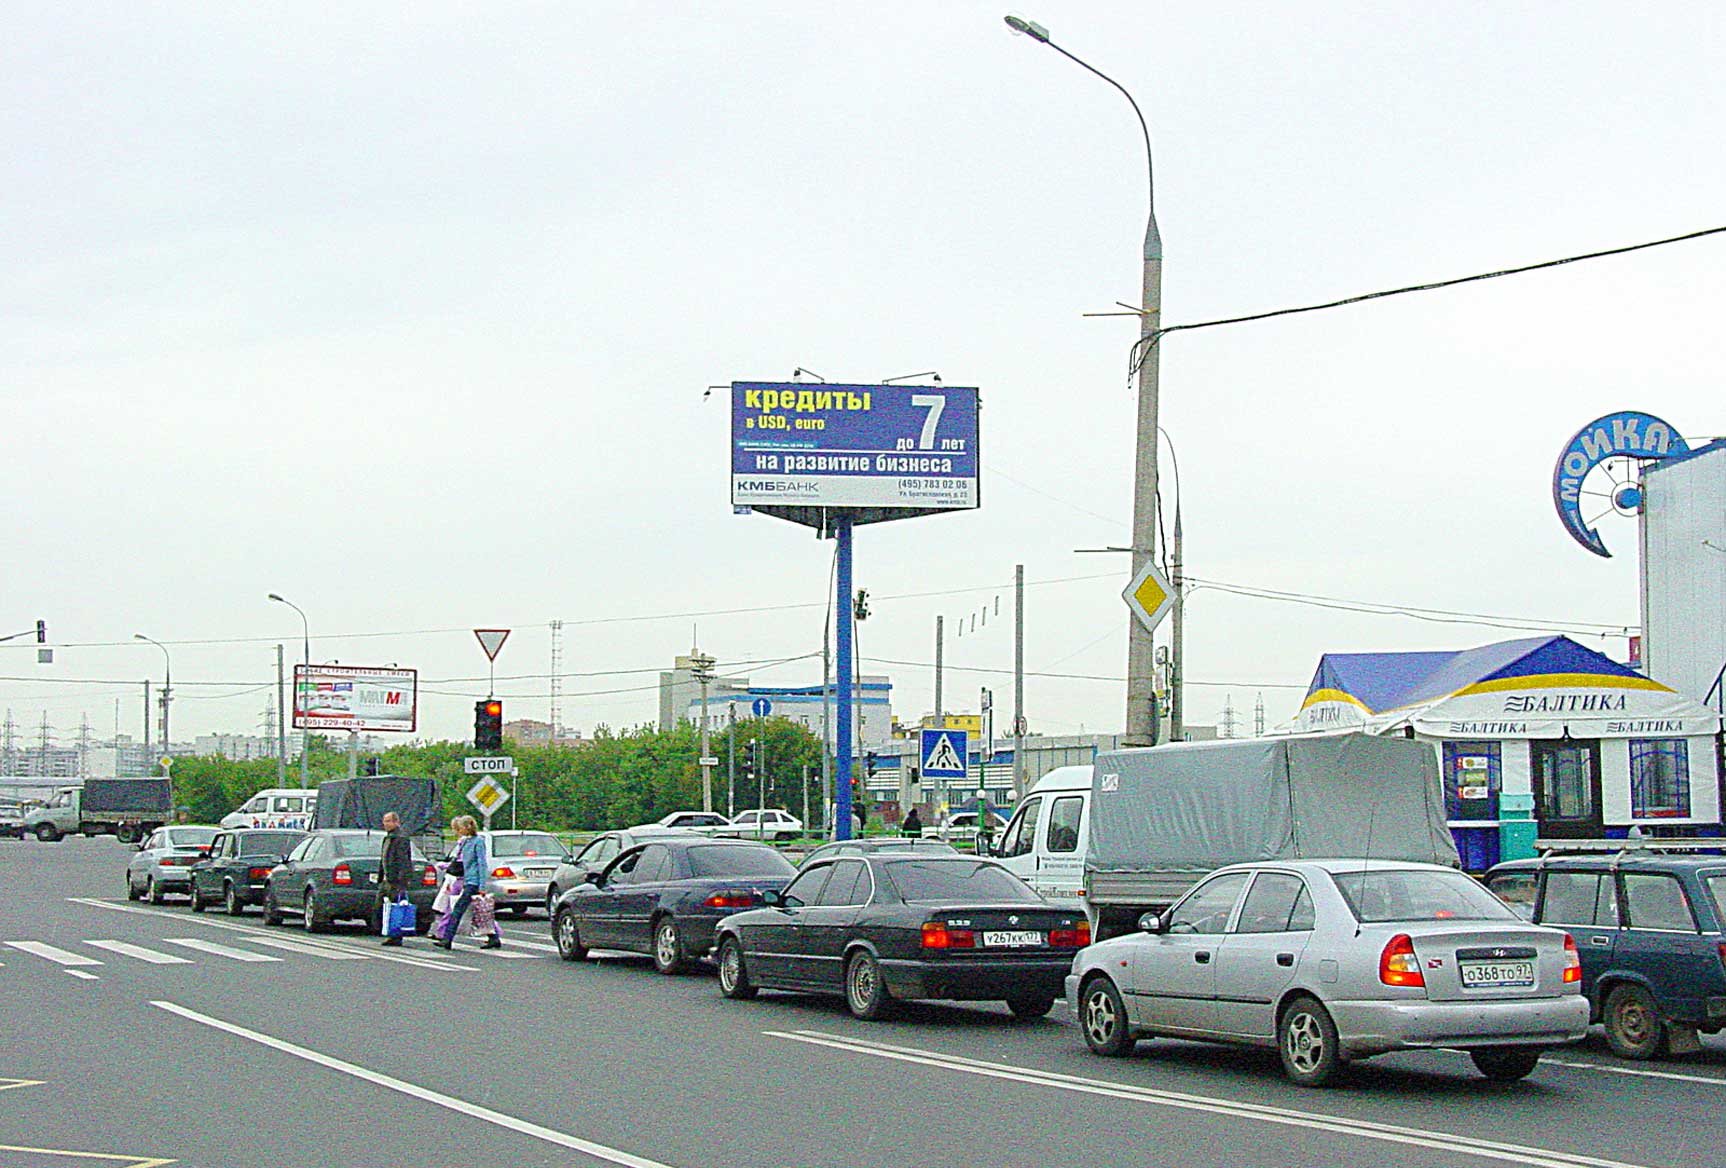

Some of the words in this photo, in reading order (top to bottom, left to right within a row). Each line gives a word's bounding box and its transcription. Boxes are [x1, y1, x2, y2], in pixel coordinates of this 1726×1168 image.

[745, 389, 871, 413] кредиты
[745, 418, 755, 429] в
[758, 415, 791, 431] USD,
[795, 418, 826, 430] euro
[896, 438, 914, 451] до
[911, 394, 946, 449] 7
[941, 439, 966, 451] лет
[756, 455, 778, 470] на
[784, 455, 870, 474] развитие
[875, 454, 952, 473] бизнеса
[1560, 418, 1670, 502] МОЙКА
[923, 480, 941, 490] 783
[1522, 694, 1627, 713] БАЛТИКА
[1460, 722, 1527, 734] БАЛТИКА
[1616, 720, 1684, 732] БАЛТИКА
[471, 760, 505, 770] СТОП
